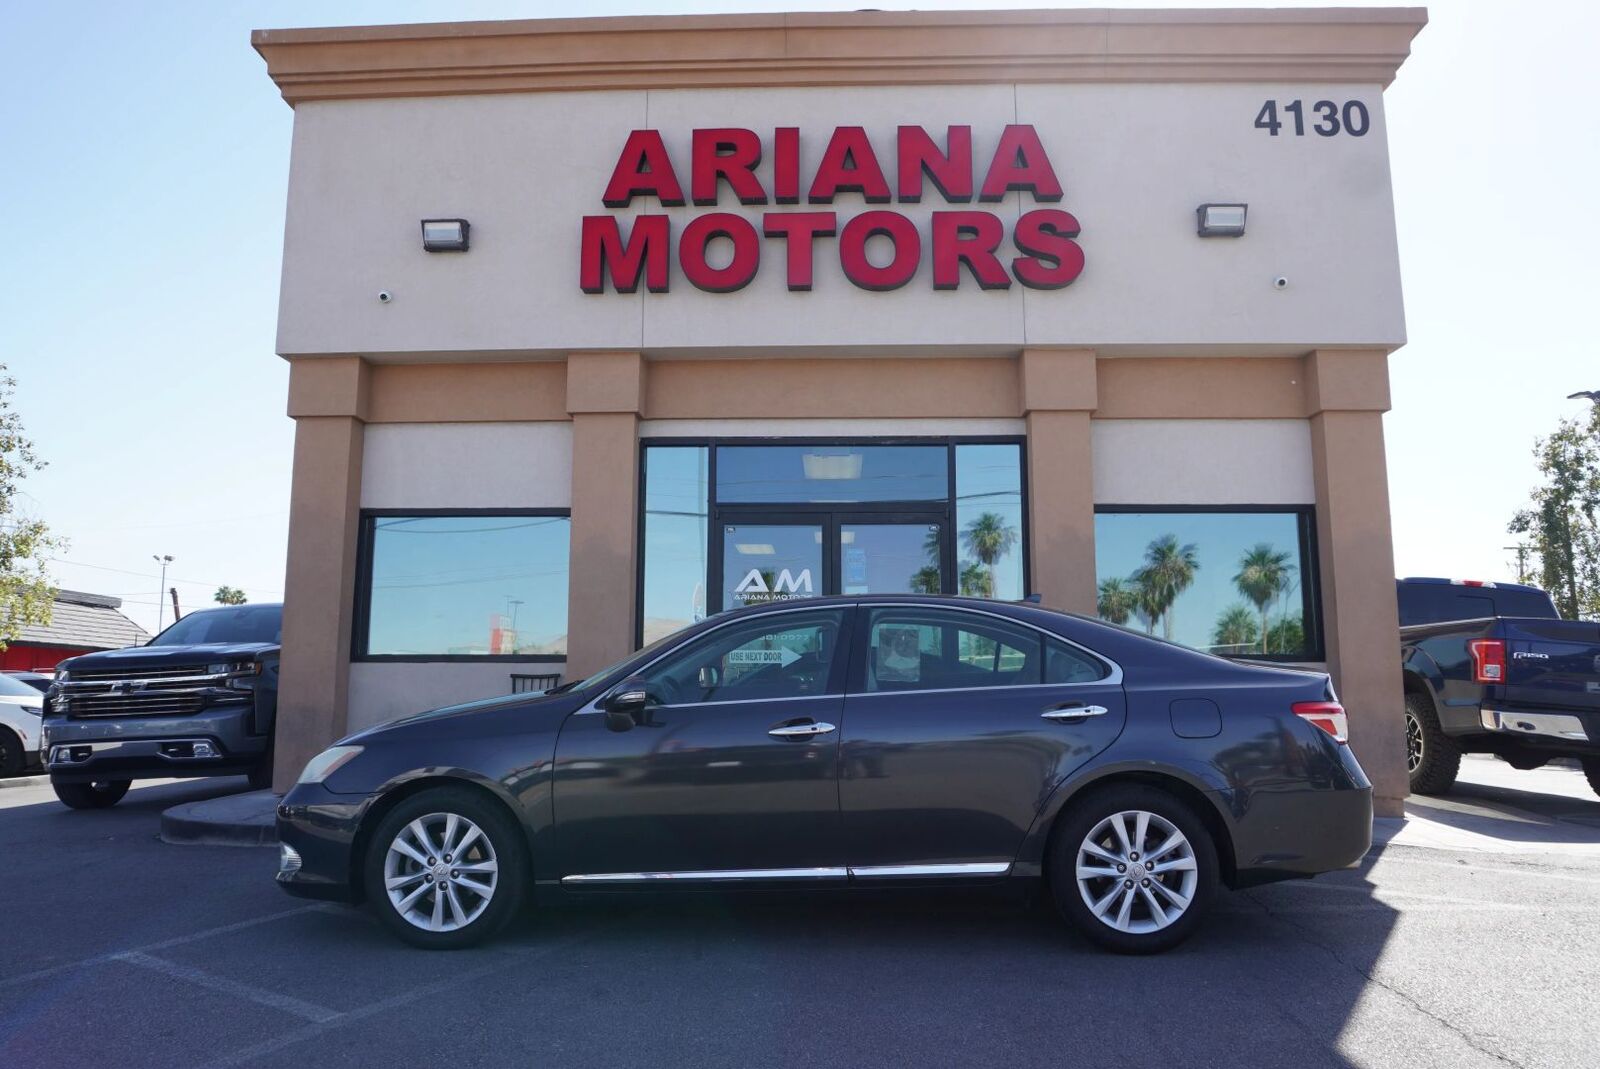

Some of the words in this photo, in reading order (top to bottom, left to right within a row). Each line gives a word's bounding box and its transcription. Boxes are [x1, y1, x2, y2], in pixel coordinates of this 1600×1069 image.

[1254, 100, 1370, 137] 4130
[602, 125, 1064, 208] ARIANA
[580, 209, 1086, 294] MOTORS
[734, 568, 813, 593] AM
[730, 651, 744, 661] USE
[745, 651, 763, 661] NEXT
[763, 651, 782, 661] DOOR
